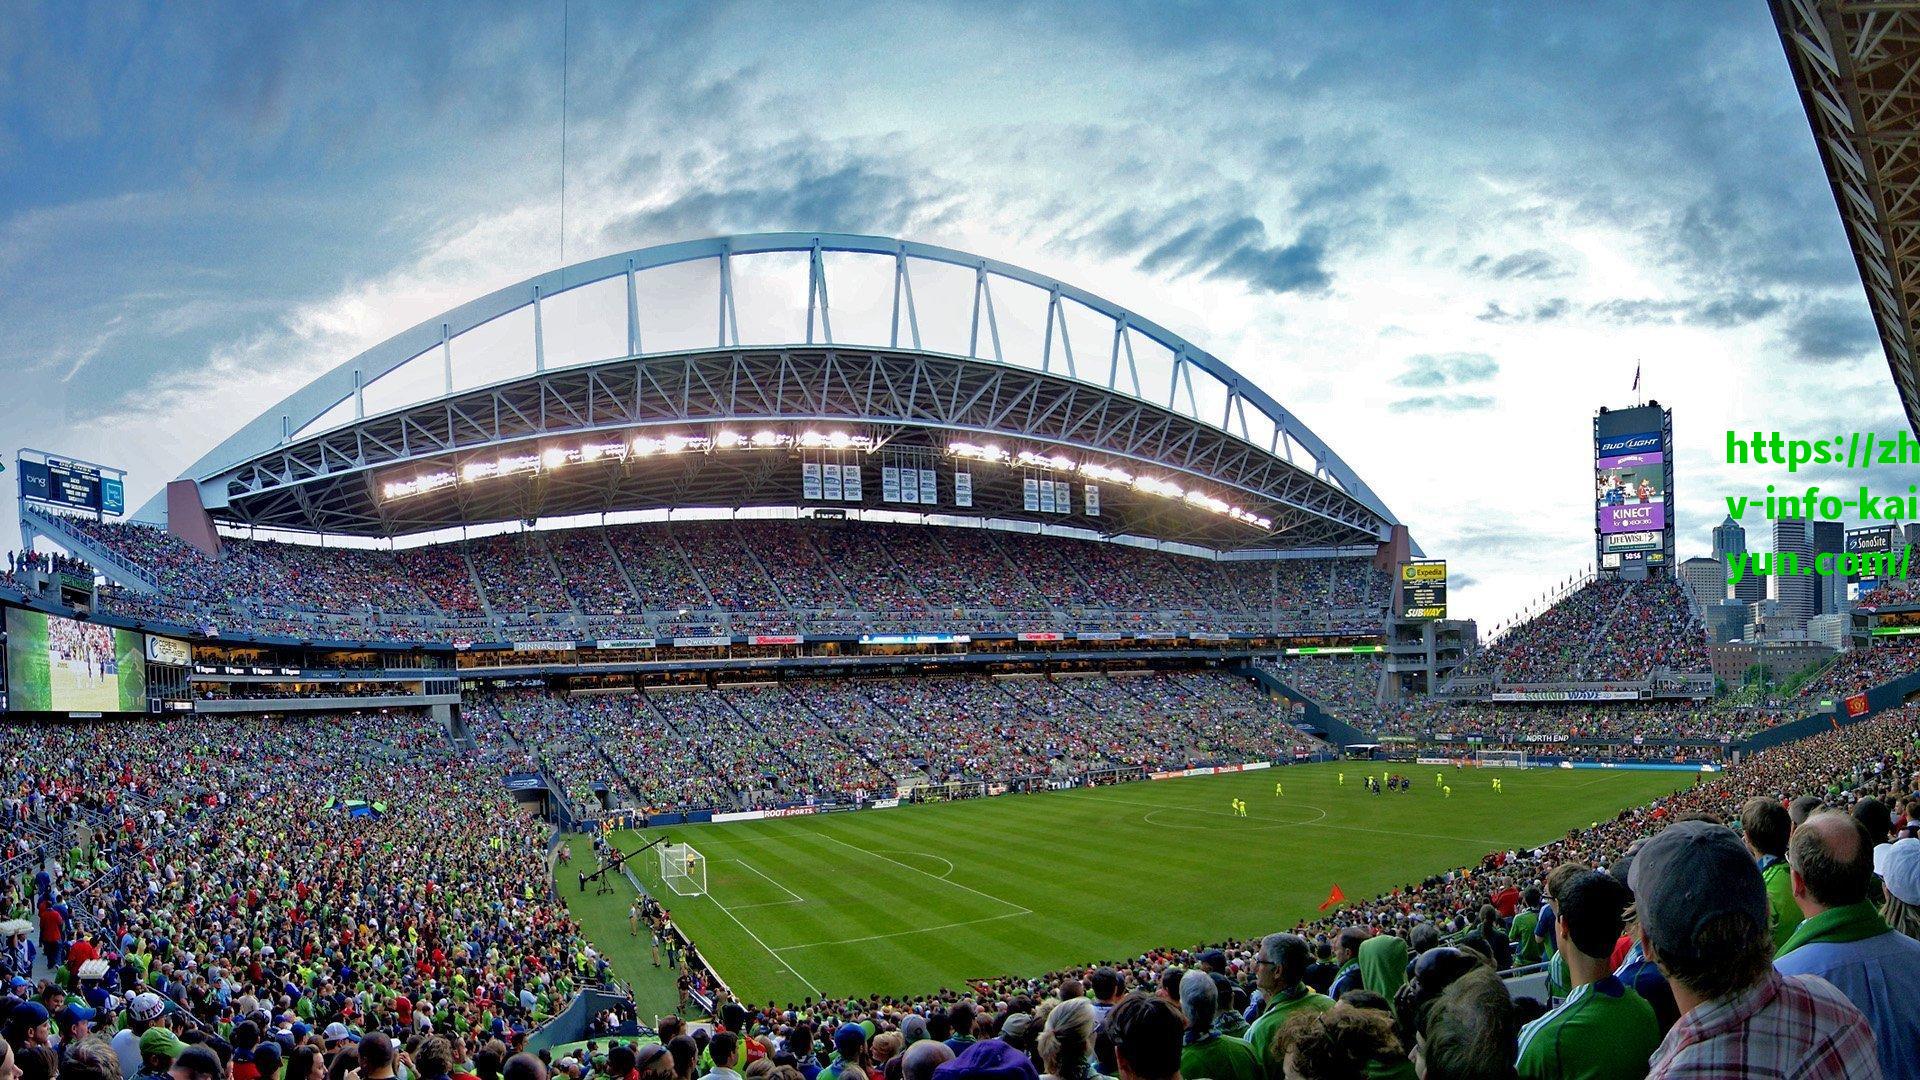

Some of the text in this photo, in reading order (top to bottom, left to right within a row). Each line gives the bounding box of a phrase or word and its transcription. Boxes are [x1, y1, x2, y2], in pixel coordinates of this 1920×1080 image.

[1629, 438, 1658, 447] LIGHT
[26, 475, 46, 487] bing
[1613, 506, 1653, 519] KINECT
[1858, 536, 1886, 548] SonoSite
[1417, 569, 1442, 577] Expedia
[1405, 608, 1444, 617] SUBWAY
[518, 642, 566, 650] PINNACLE
[764, 809, 786, 818] ROOT
